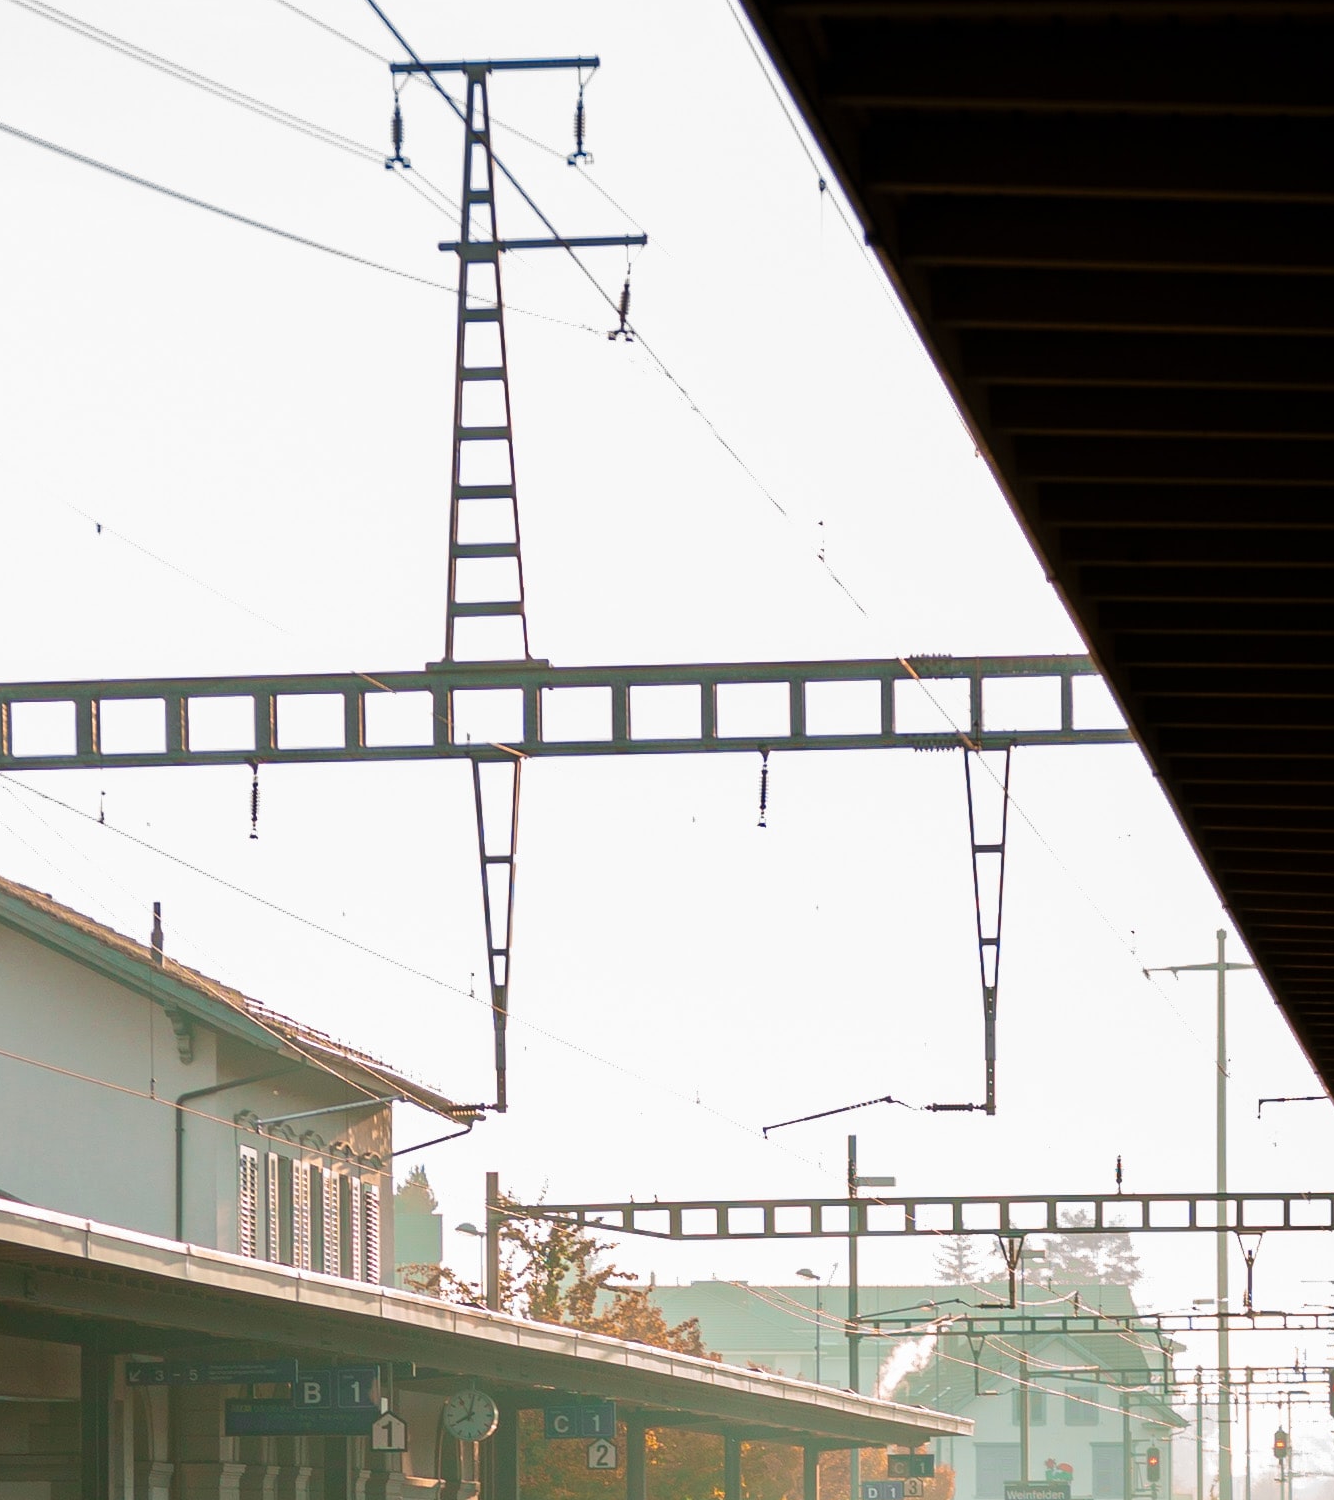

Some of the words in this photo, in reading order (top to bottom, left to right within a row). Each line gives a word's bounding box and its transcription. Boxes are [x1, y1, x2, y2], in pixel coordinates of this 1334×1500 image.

[154, 1369, 165, 1382] 3
[188, 1369, 199, 1381] 5
[303, 1381, 322, 1404] B
[350, 1380, 361, 1403] 1
[554, 1414, 570, 1433] C
[592, 1414, 600, 1432] 1
[381, 1420, 393, 1448] 1
[596, 1444, 609, 1466] 2
[919, 1463, 926, 1474] 1
[868, 1487, 878, 1499] D
[890, 1487, 896, 1499] 1
[908, 1480, 917, 1495] 3
[1006, 1489, 1065, 1500] Weinfelden
